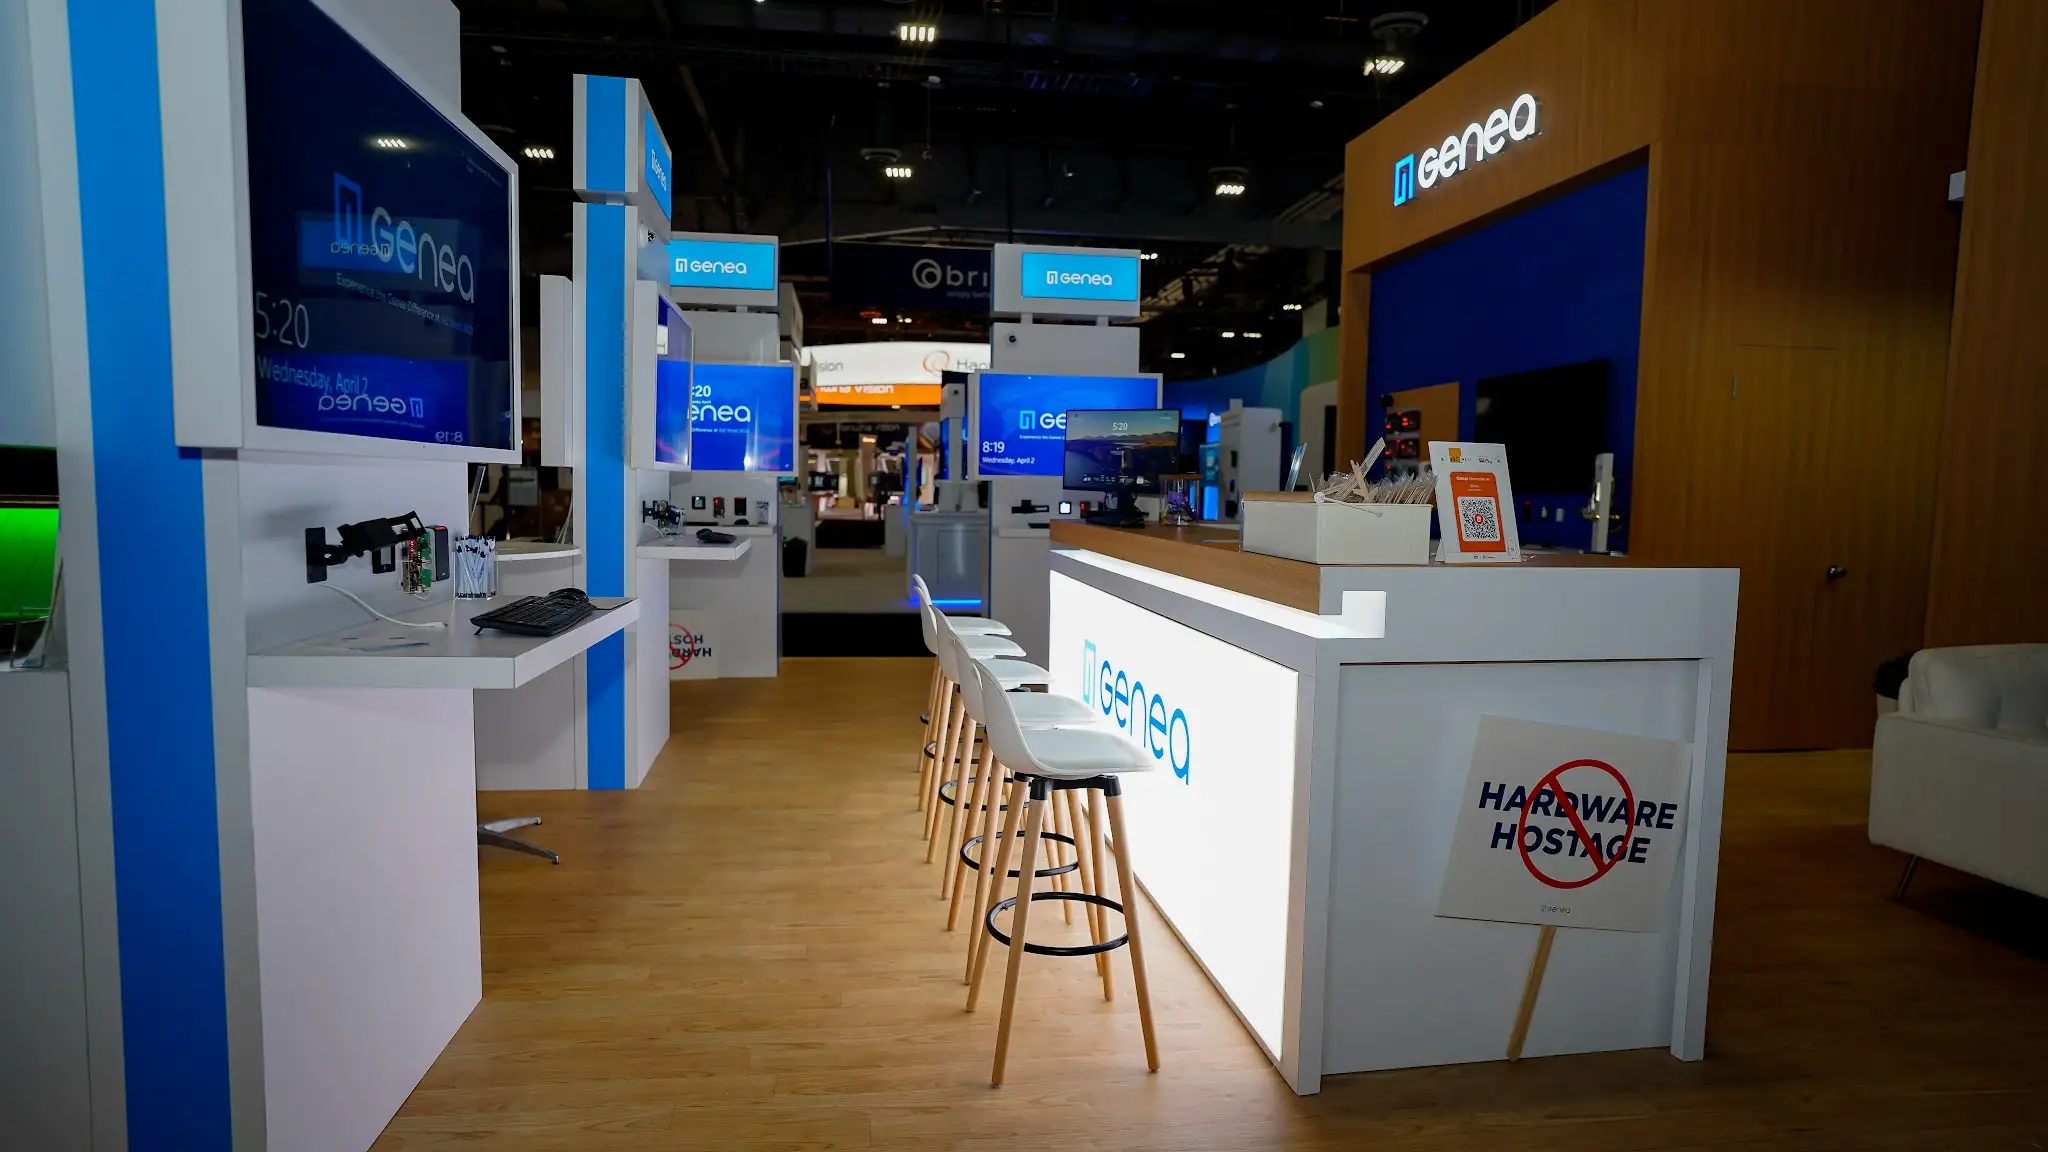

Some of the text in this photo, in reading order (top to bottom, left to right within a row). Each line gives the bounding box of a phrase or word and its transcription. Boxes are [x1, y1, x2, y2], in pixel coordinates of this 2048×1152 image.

[1417, 93, 1537, 189] Genea
[370, 206, 475, 304] Genea
[690, 258, 747, 275] Genea
[1059, 272, 1113, 286] Genea
[255, 291, 310, 349] 5:20
[256, 354, 333, 394] Wednesday,
[336, 372, 360, 395] April
[982, 441, 1005, 453] 8:19
[1112, 422, 1128, 431] 5:20
[982, 456, 1015, 465] Wednesday,
[1016, 456, 1029, 465] April
[1100, 660, 1190, 786] Genea
[1478, 781, 1678, 830] HARDWARE
[1490, 821, 1651, 864] HOSTAGE
